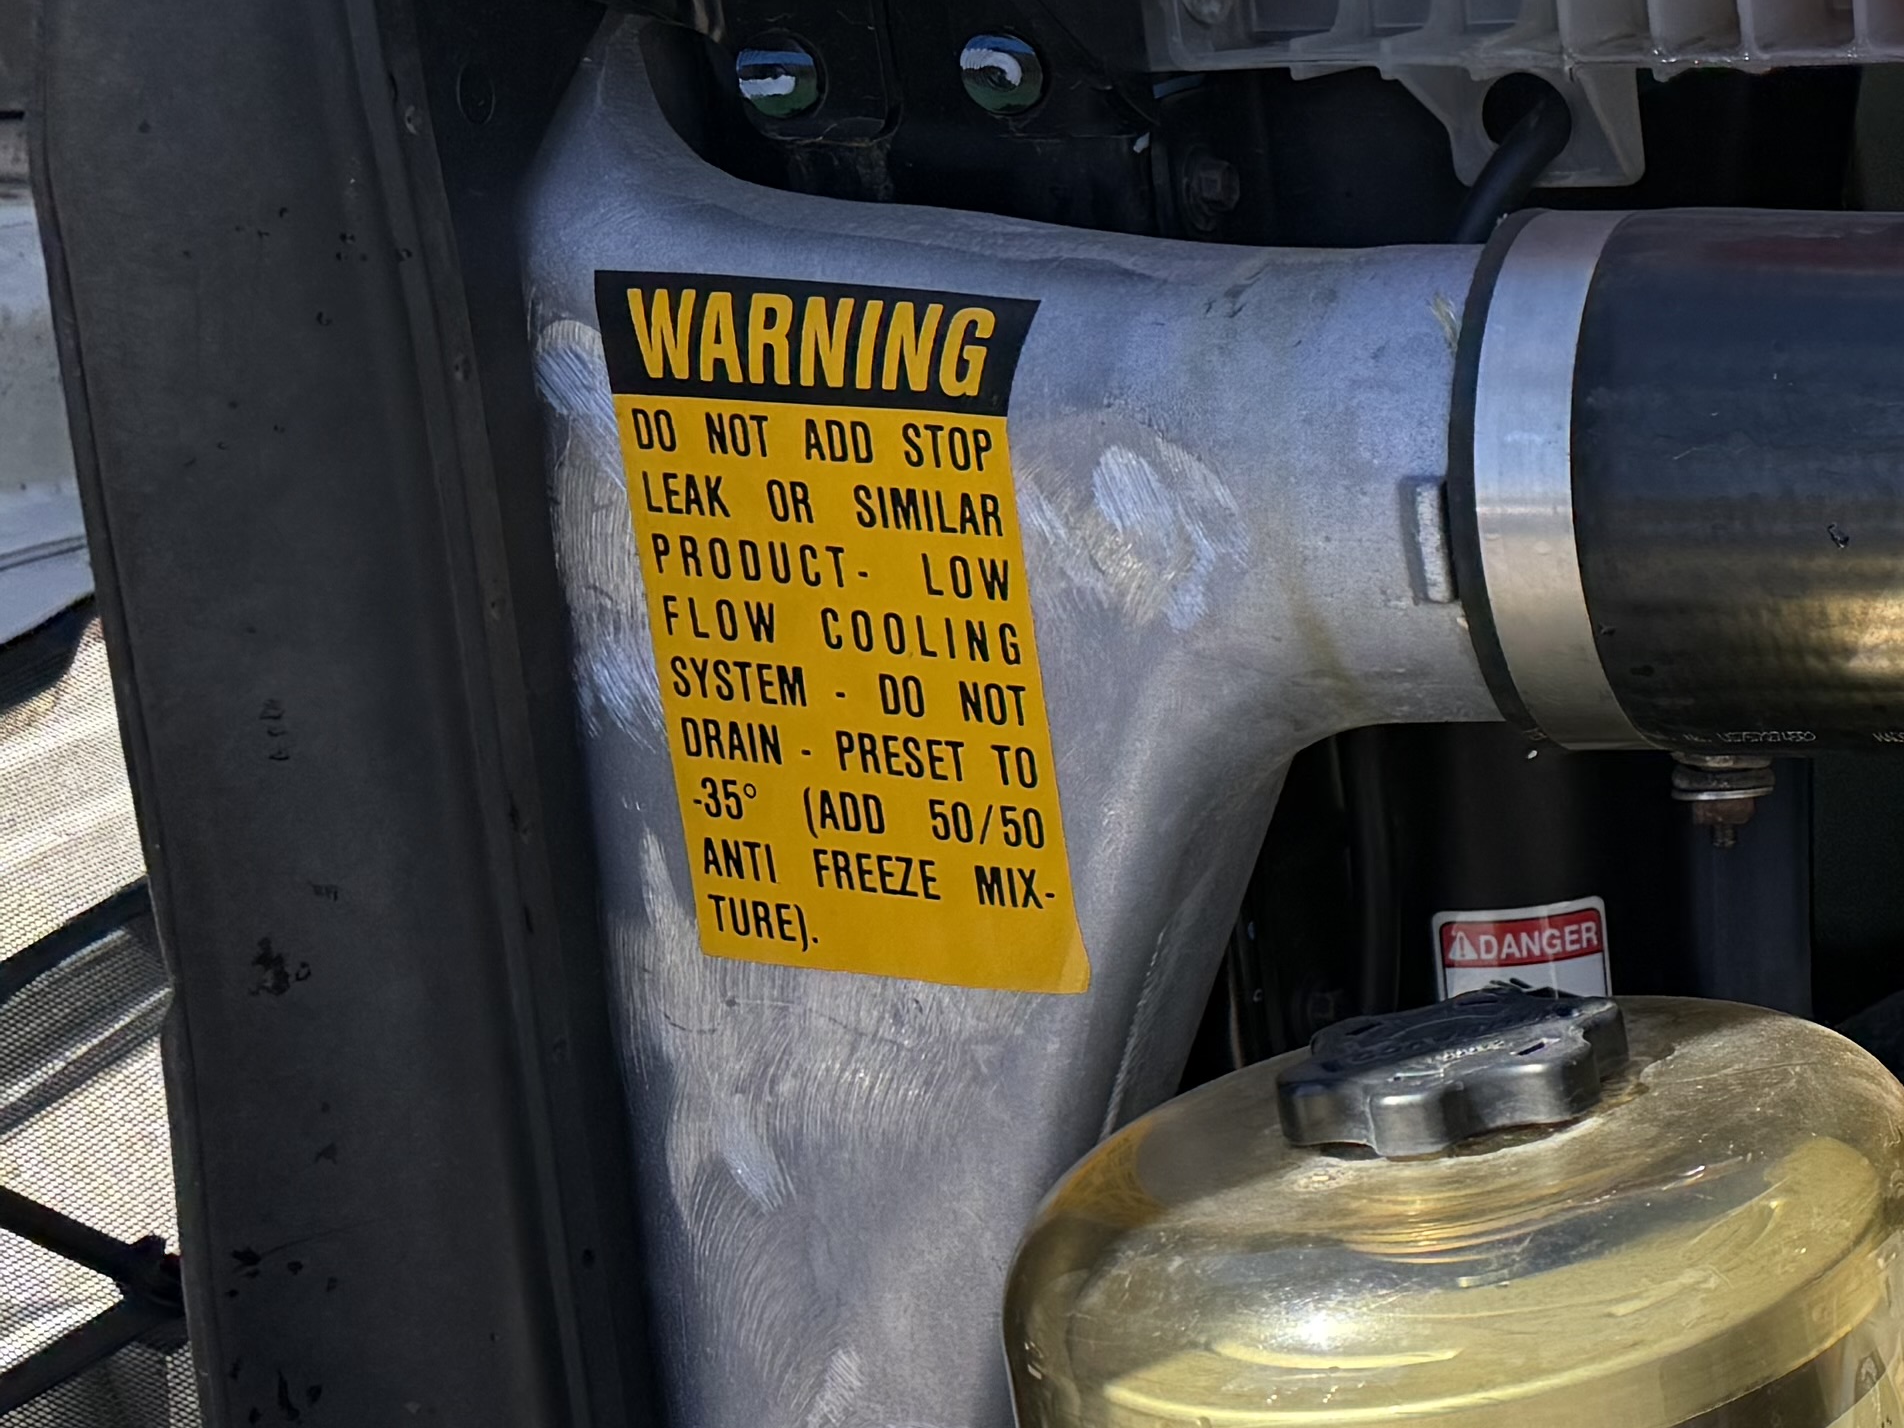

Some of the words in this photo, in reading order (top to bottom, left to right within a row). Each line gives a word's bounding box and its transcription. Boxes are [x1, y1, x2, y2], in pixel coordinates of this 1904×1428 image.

[626, 287, 997, 398] WARNING
[631, 408, 677, 453] DO
[706, 415, 770, 459] NOT
[804, 418, 874, 465] ADD
[902, 423, 993, 472] STOP
[642, 471, 731, 519] LEAK
[768, 481, 812, 526] OR
[855, 486, 1003, 538] SIMILAR
[653, 532, 870, 590] PRODUCT-
[921, 553, 1011, 603] LOW
[663, 595, 776, 645] FLOW
[821, 607, 1021, 667] COOLING
[672, 657, 807, 708] SYSTEM
[880, 675, 925, 719] DO
[962, 683, 1027, 727] NOT
[681, 716, 782, 766] DRAIN
[836, 730, 965, 783] PRESET
[991, 744, 1038, 789] TO
[692, 777, 758, 821] -35°
[803, 790, 886, 838] (ADD
[931, 805, 1046, 850] 50/50
[703, 840, 778, 884] ANTI
[812, 847, 942, 902] FREEZE
[976, 865, 1055, 910] MIX-
[707, 894, 820, 952] TURE).
[1479, 921, 1598, 960] DANGER
